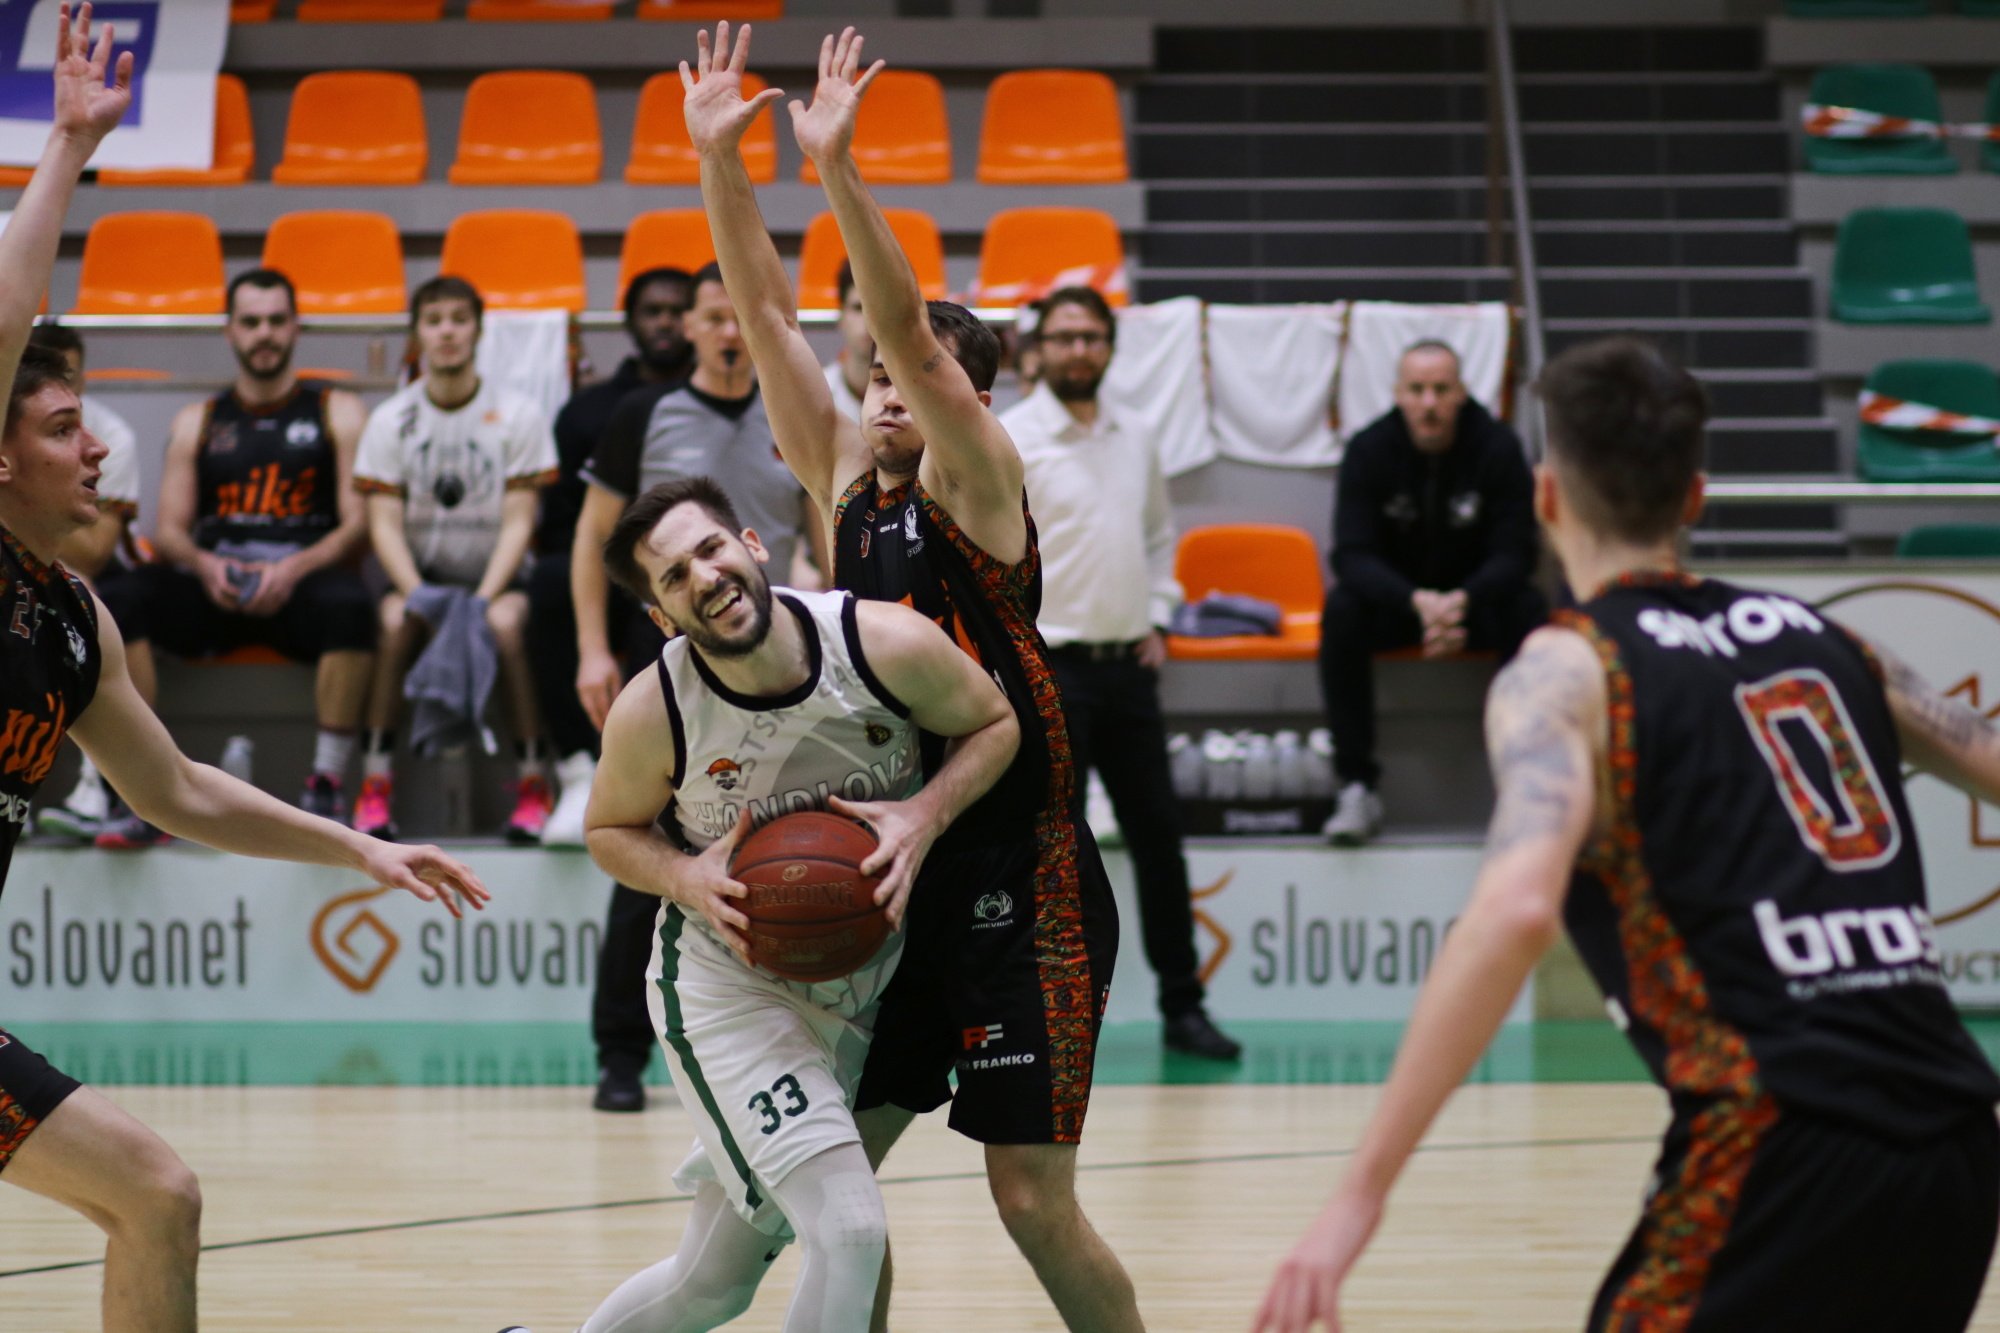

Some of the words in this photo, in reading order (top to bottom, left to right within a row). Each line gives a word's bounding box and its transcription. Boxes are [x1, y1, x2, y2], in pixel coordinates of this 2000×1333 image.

[696, 750, 908, 838] HANDLOV
[1734, 667, 1901, 873] 0
[10, 886, 250, 988] slovanet
[748, 880, 857, 911] PALDING
[1252, 884, 1459, 987] slovan
[748, 1073, 809, 1135] 33
[973, 1053, 1035, 1070] FRANKO
